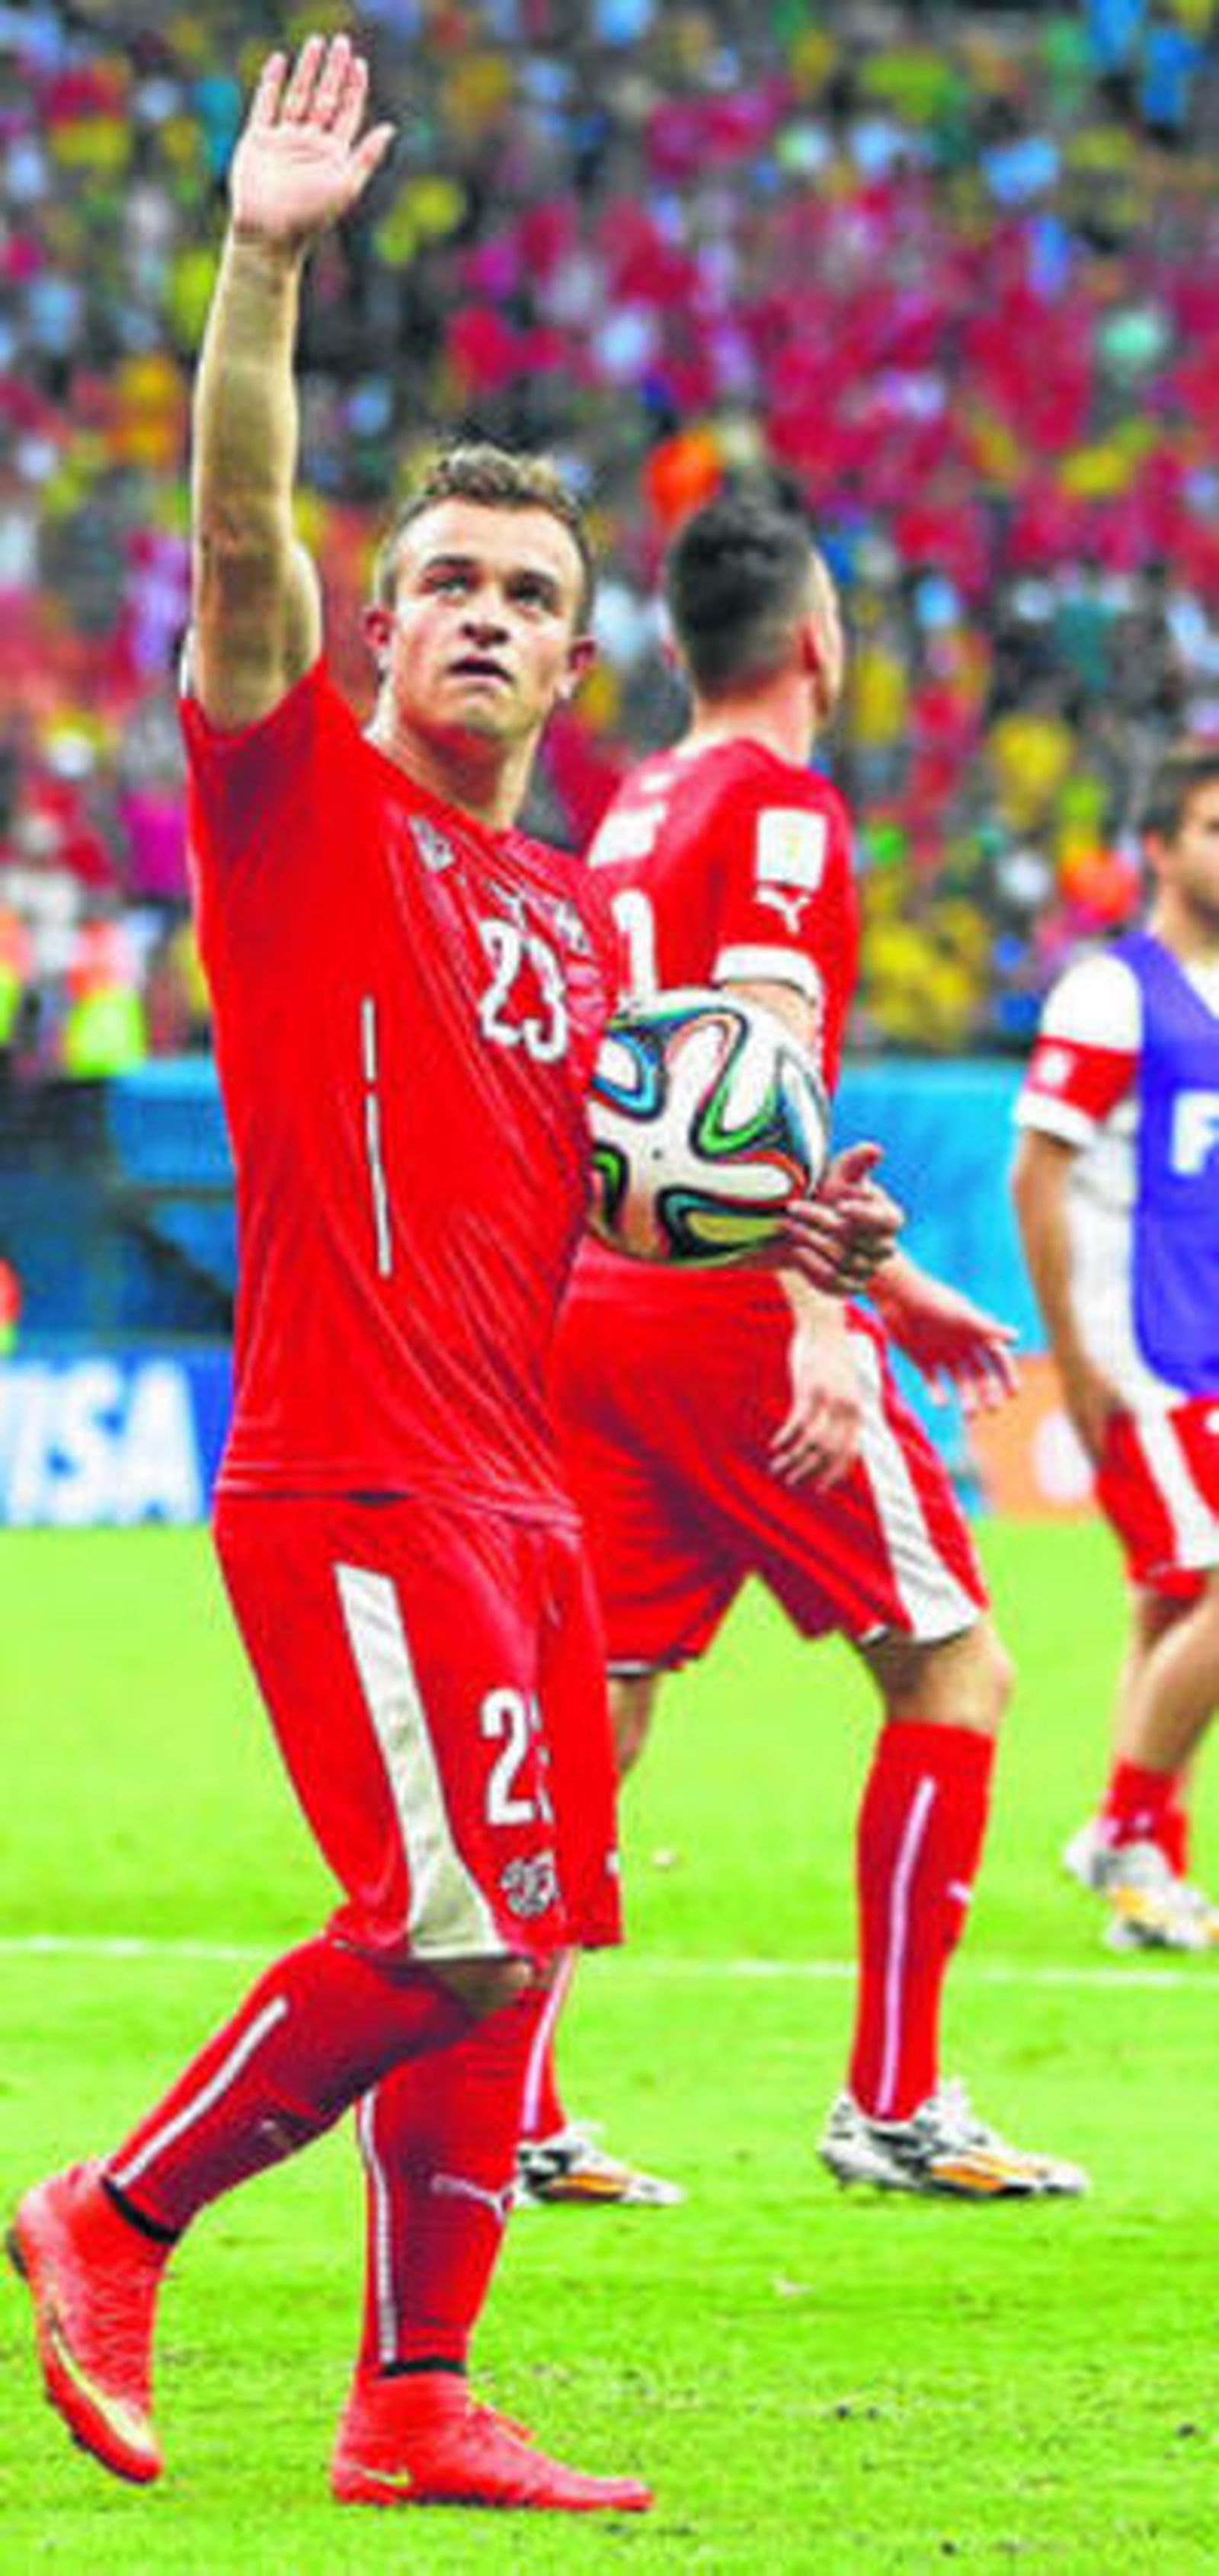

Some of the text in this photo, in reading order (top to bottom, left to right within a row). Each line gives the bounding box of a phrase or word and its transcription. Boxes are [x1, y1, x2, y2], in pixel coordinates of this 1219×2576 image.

[476, 917, 568, 1063] 23
[0, 1360, 200, 1525] ISA
[480, 1687, 555, 1826] 2
